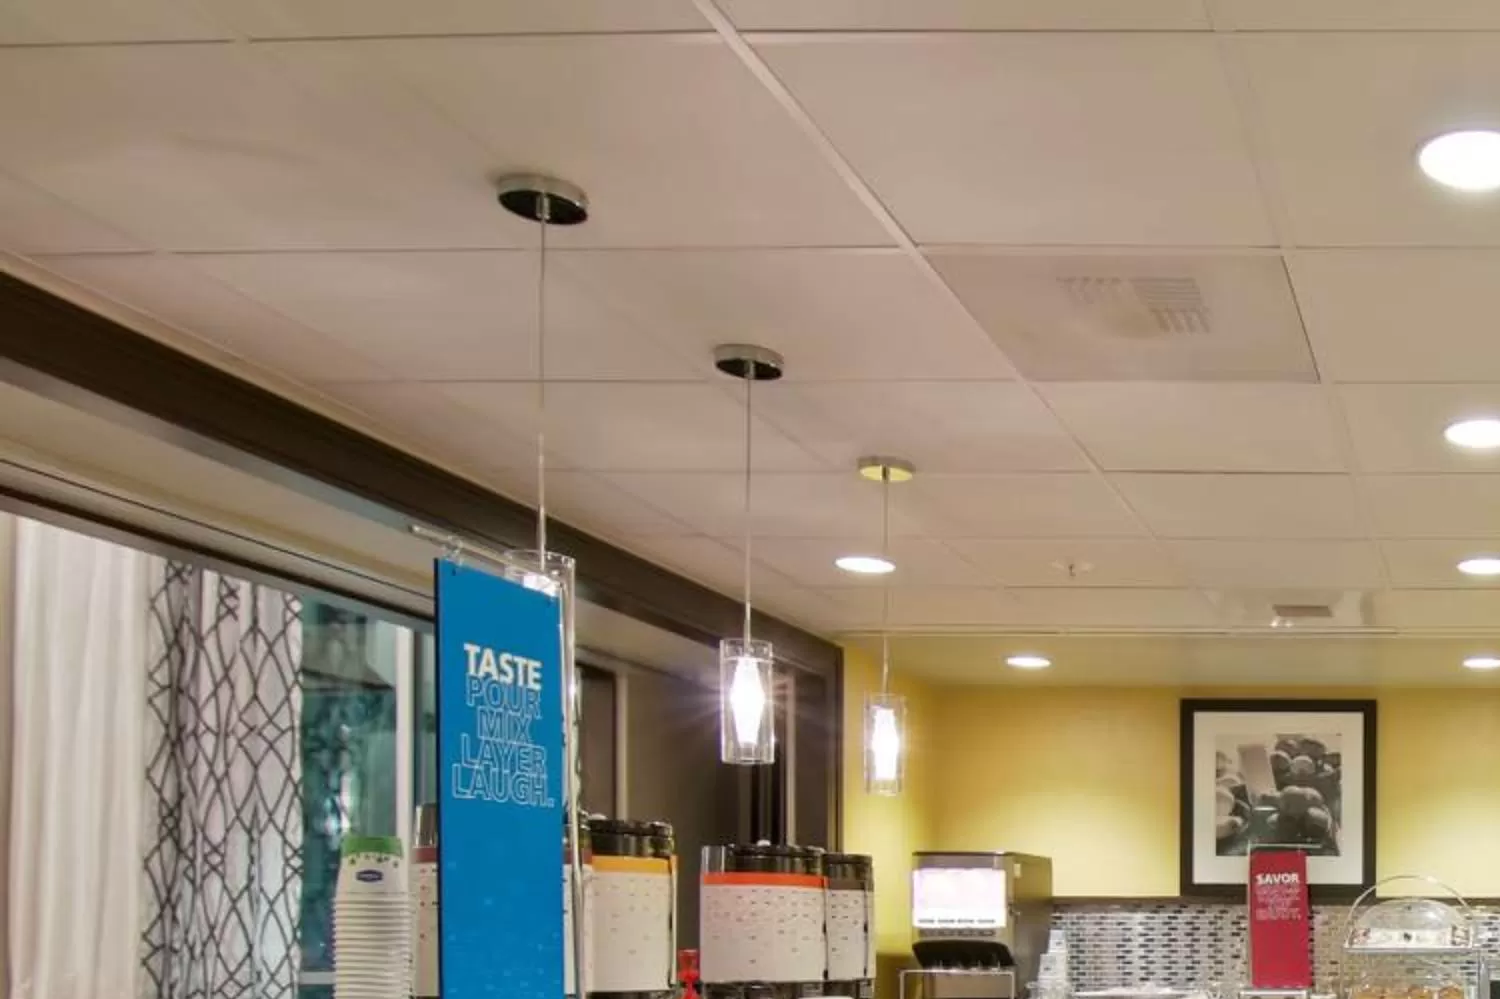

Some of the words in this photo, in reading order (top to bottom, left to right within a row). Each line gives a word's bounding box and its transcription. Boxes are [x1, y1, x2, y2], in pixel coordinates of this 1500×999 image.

[463, 643, 543, 690] TASTE
[466, 675, 543, 720] POUR
[476, 705, 533, 744] MIX
[460, 733, 548, 777] LAYER
[451, 763, 555, 808] LAUGH.
[1255, 873, 1299, 885] SAVOR
